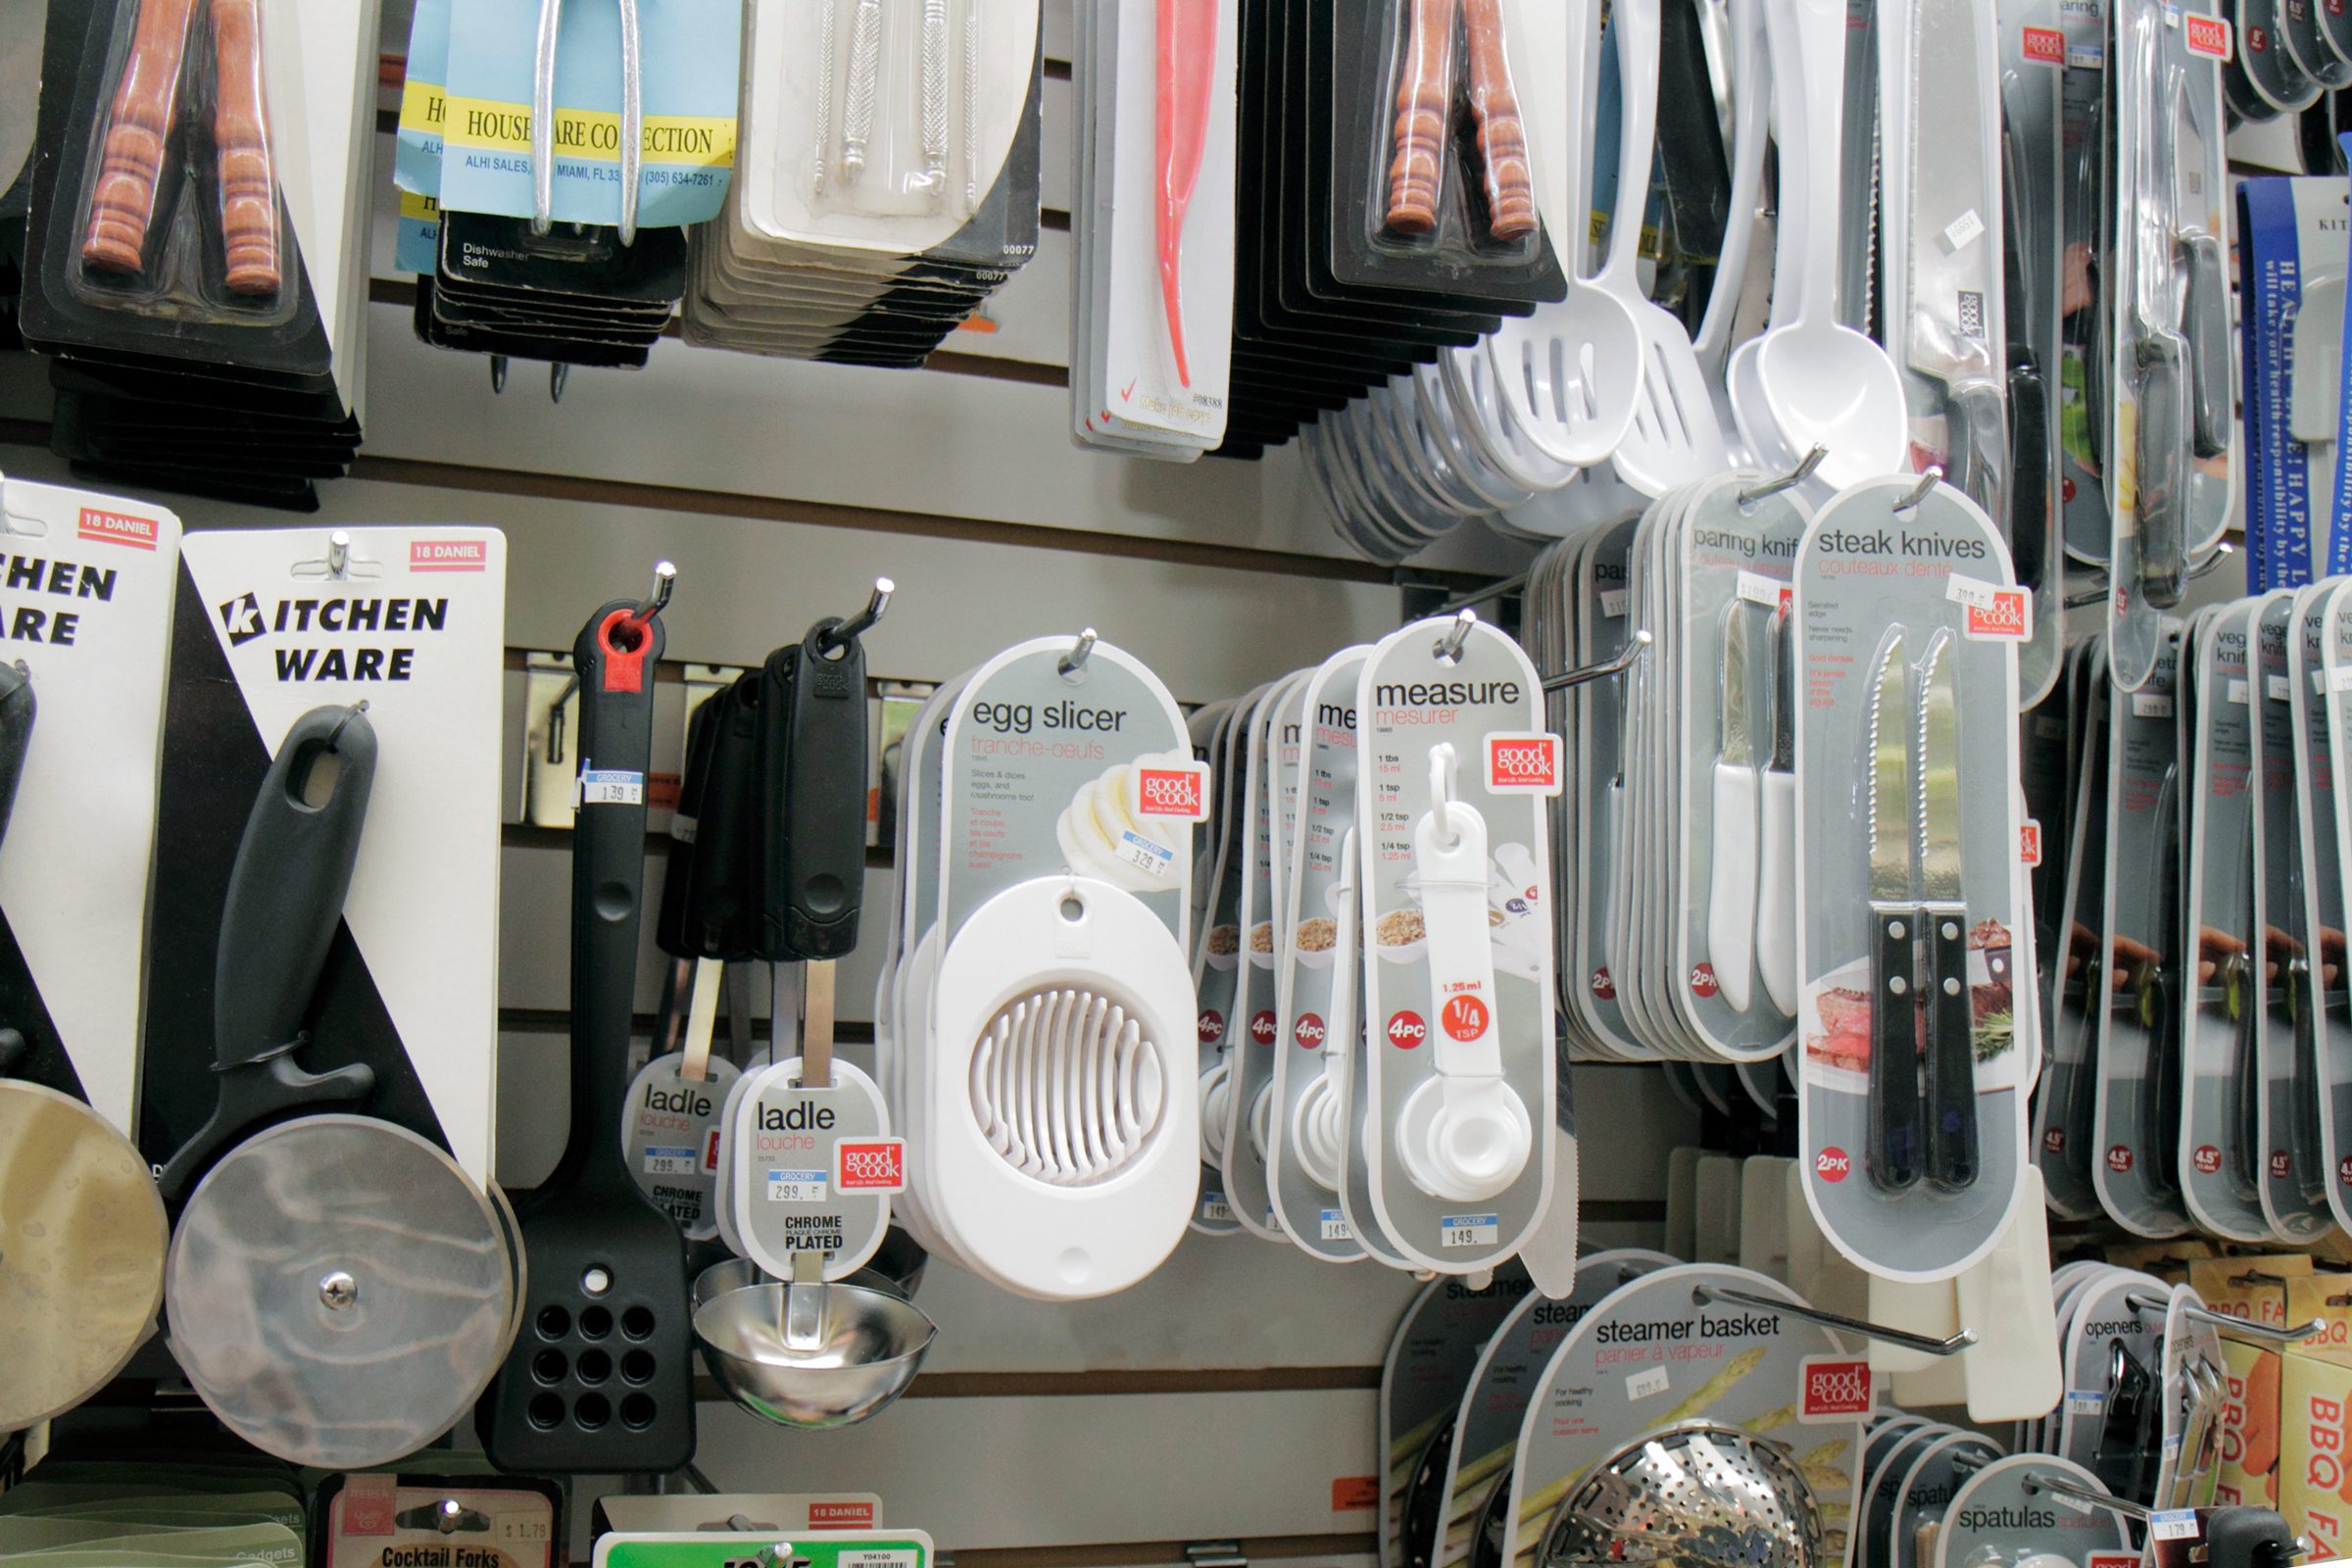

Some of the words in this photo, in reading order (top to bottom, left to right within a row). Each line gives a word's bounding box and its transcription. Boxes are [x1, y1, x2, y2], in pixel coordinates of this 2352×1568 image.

[467, 111, 586, 147] HOUSEARE
[591, 124, 713, 155] COECTION
[465, 155, 491, 170] ALHI
[493, 157, 530, 174] SALES,
[557, 165, 590, 180] MIAMI,
[593, 169, 606, 181] FL
[645, 171, 669, 186] (305)
[671, 172, 714, 188] 634-7261
[464, 243, 530, 262] Dishwasher
[1003, 245, 1035, 255] 00077
[464, 256, 489, 269] Safe
[2266, 261, 2278, 289] will
[2266, 293, 2280, 327] take
[2266, 330, 2282, 368] your
[84, 514, 101, 526] 18
[105, 516, 152, 536] DANIEL
[2288, 473, 2307, 557] HAPPY
[416, 547, 430, 559] 18
[434, 547, 480, 558] DANIEL
[1692, 528, 1755, 558] paring
[1762, 534, 1797, 557] knif
[1819, 529, 1892, 556] steak
[1901, 531, 1986, 560] knives
[1818, 557, 1899, 575] couteaux
[1984, 608, 2022, 625] cook
[275, 649, 415, 681] WARE
[2217, 648, 2245, 664] knif
[1377, 681, 1520, 707] measure
[973, 702, 1032, 734] egg
[1043, 700, 1127, 732] slicer
[1376, 707, 1458, 726] mesurer
[971, 735, 1104, 760] tranche-oeufs
[1497, 742, 1544, 769] good
[1386, 755, 1399, 763] tbs
[1508, 755, 1551, 775] cook
[972, 770, 995, 779] Slices
[1146, 774, 1190, 799] good
[1154, 787, 1199, 806] cook
[1386, 784, 1400, 793] tsp
[1396, 813, 1409, 822] tsp
[1396, 842, 1410, 852] tsp
[1592, 973, 1611, 989] 2P
[1452, 1000, 1481, 1028] 1/4
[1199, 1015, 1222, 1035] 4PC
[1296, 1018, 1324, 1038] 4PC
[1388, 1018, 1424, 1037] 4PC
[1455, 1028, 1479, 1039] TSP
[645, 1083, 711, 1117] ladle
[758, 1101, 835, 1130] ladle
[757, 1133, 815, 1151] louche
[846, 1146, 891, 1171] good
[857, 1159, 900, 1178] cook
[1818, 1154, 1848, 1170] 2PK
[779, 1172, 816, 1181] GROCERY
[653, 1185, 703, 1201] CHROME
[775, 1185, 804, 1200] 299.
[785, 1215, 842, 1229] CHROME
[1452, 1216, 1487, 1226] GROCERY
[785, 1235, 843, 1250] PLATED
[1596, 1319, 1694, 1344] steamer
[1700, 1312, 1780, 1338] basket
[2085, 1319, 2142, 1339] openers
[1594, 1347, 1646, 1366] panier
[1652, 1346, 1663, 1360] à
[1669, 1343, 1725, 1362] vapeur
[1812, 1368, 1859, 1395] good
[1822, 1384, 1868, 1403] cook
[2306, 1396, 2341, 1490] BBQ
[1960, 1505, 2055, 1532] spatulas
[520, 1523, 546, 1538] 1.79
[382, 1547, 449, 1568] Cocktail
[456, 1549, 499, 1568] Forks
